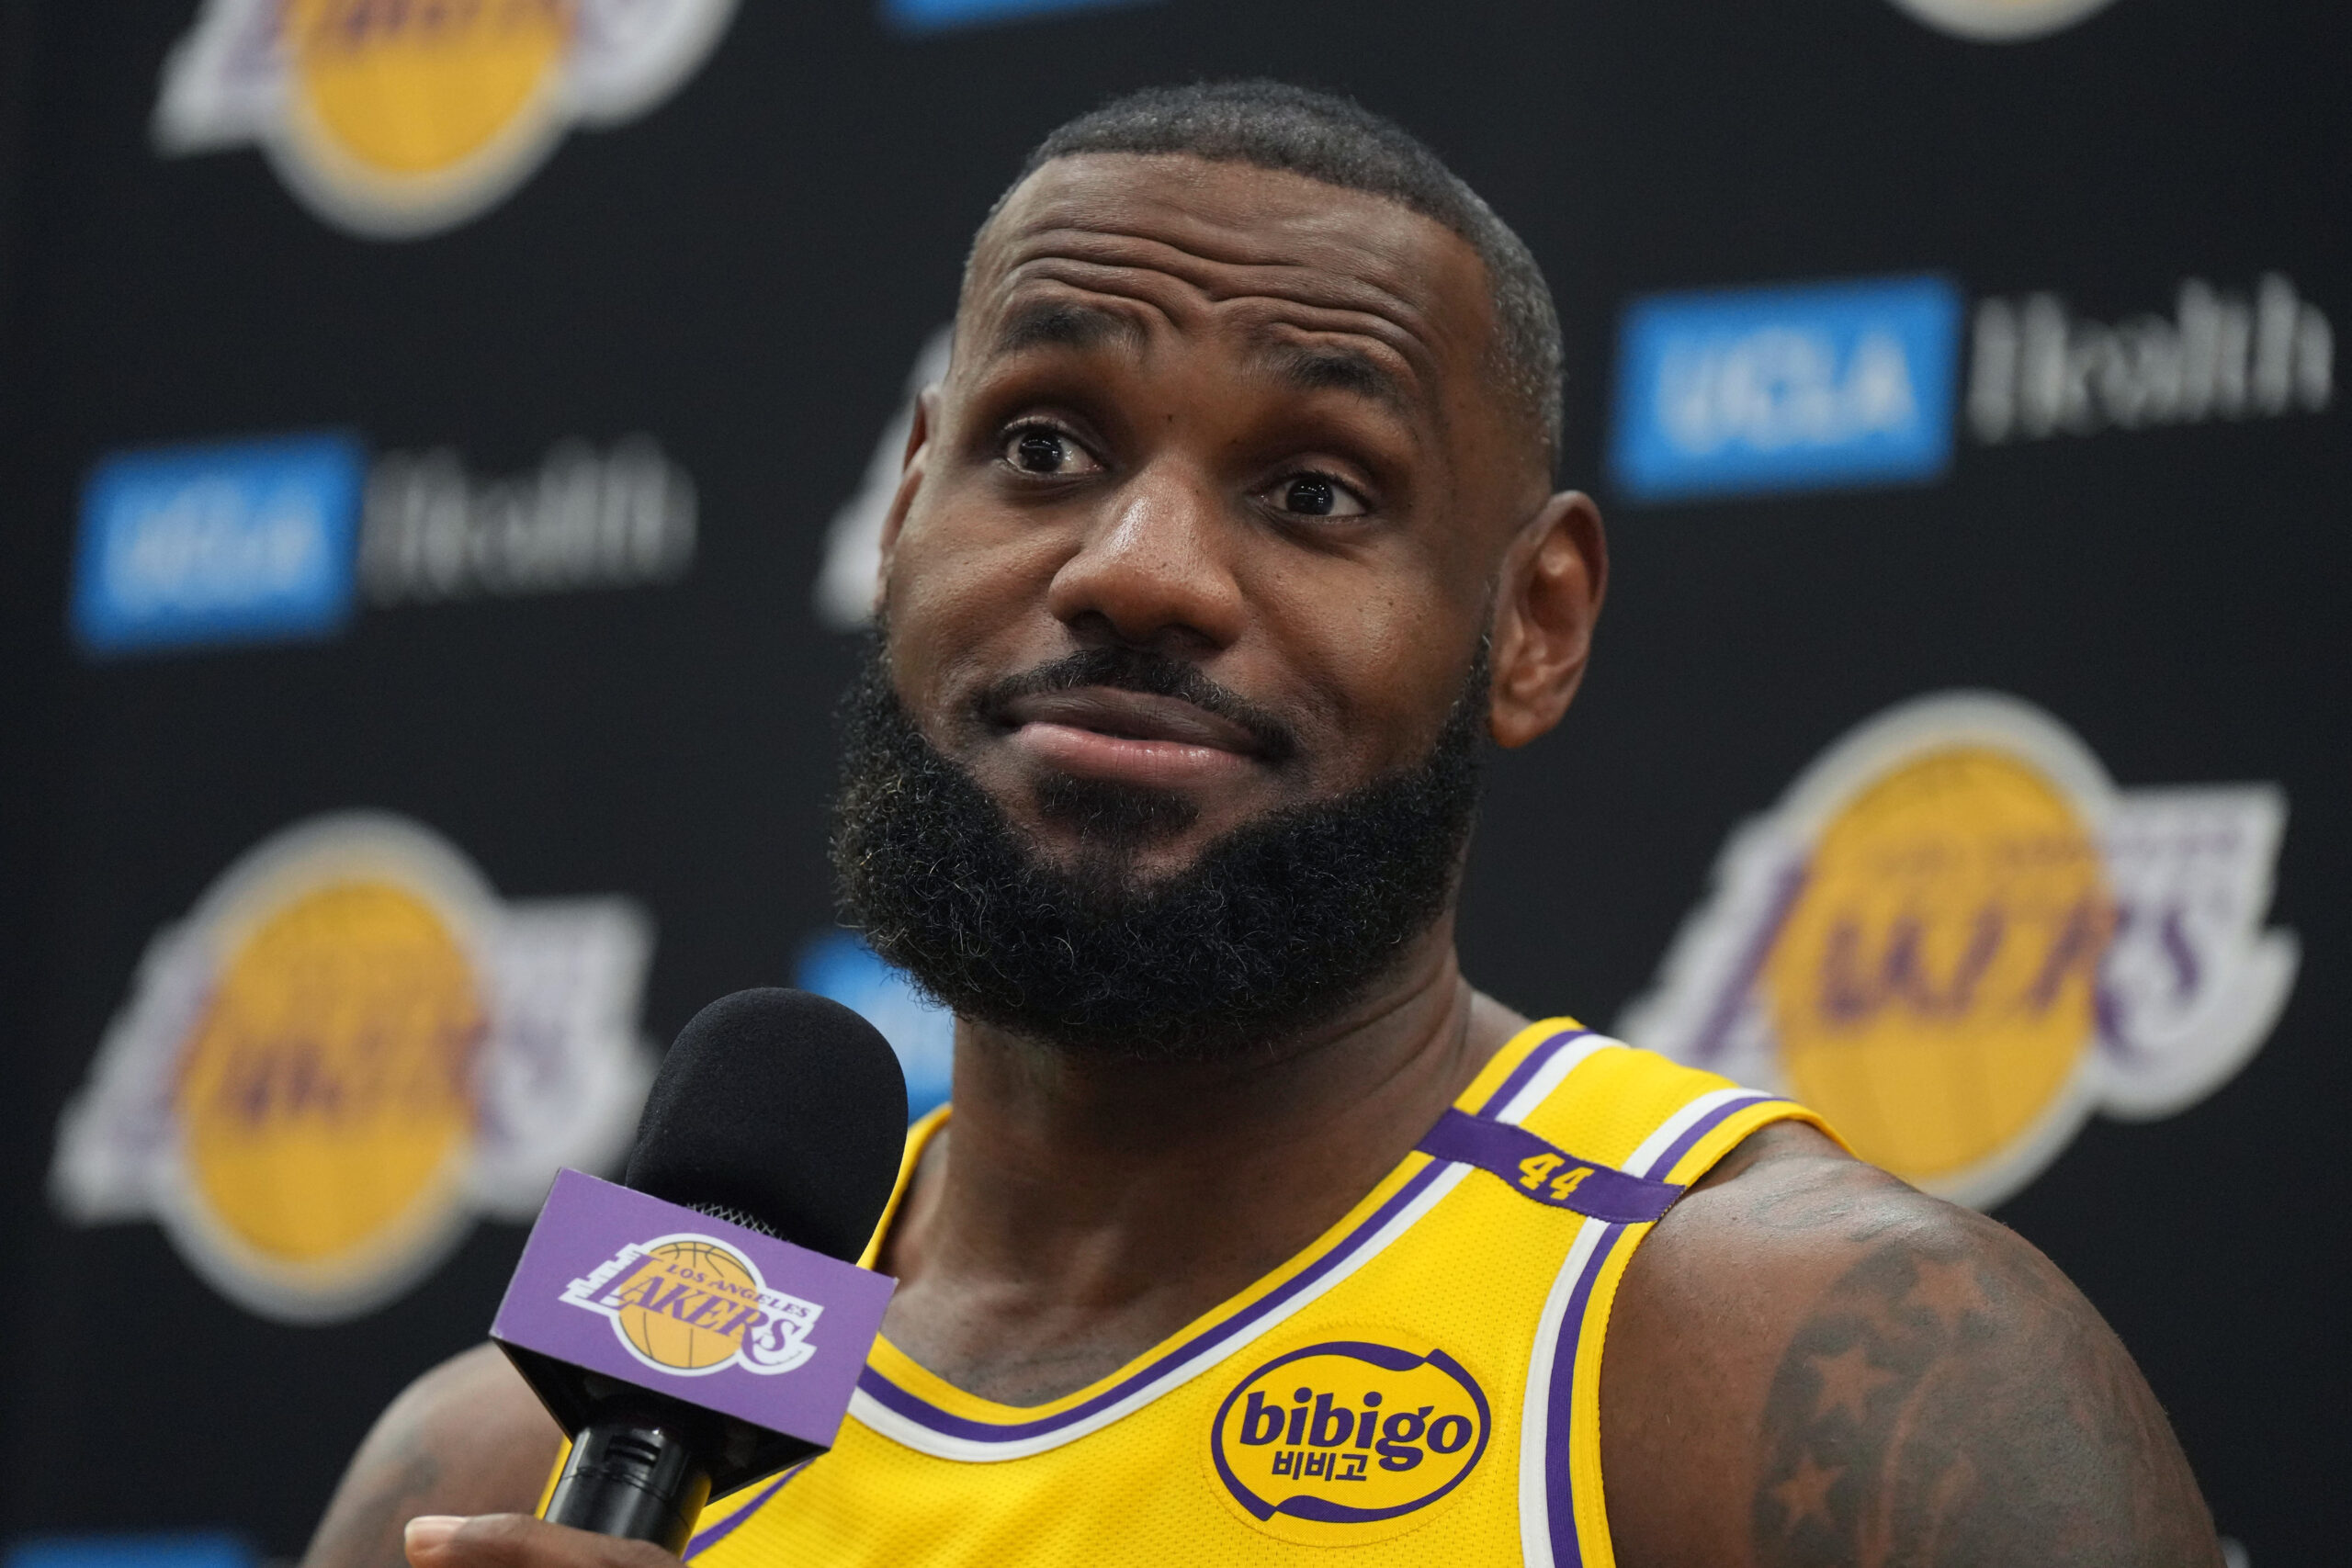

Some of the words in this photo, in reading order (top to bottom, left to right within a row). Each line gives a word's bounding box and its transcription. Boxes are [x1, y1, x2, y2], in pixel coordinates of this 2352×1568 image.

[1518, 1152, 1595, 1201] 44
[575, 1250, 803, 1366] LAKERS
[665, 1263, 706, 1283] LOS
[710, 1279, 811, 1318] ANGELES
[1239, 1386, 1473, 1472] bibigo
[1272, 1450, 1368, 1482] 비비고
